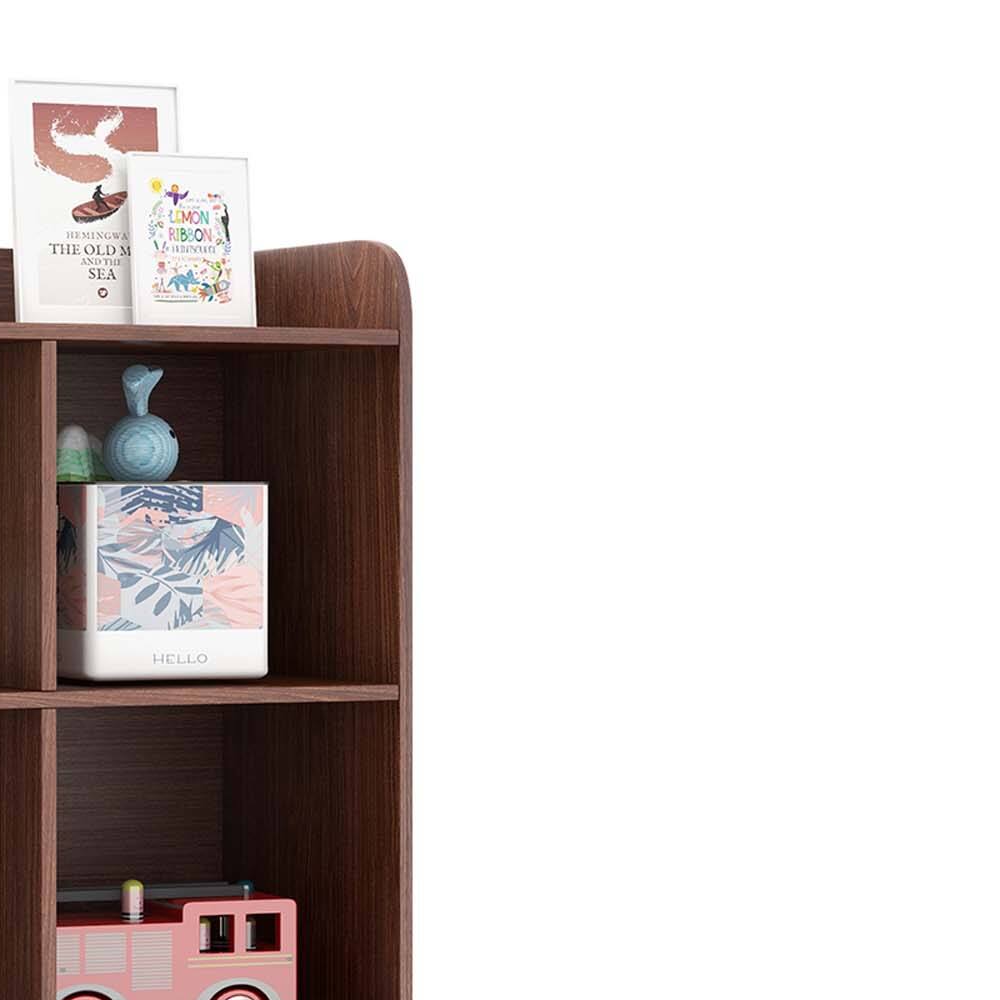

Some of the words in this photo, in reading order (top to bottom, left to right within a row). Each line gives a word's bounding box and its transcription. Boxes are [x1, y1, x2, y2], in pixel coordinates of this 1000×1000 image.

[168, 209, 209, 224] LEMON
[66, 231, 130, 240] HEMINGWA
[168, 227, 213, 242] RIBBON
[48, 242, 81, 255] THE
[83, 243, 117, 256] OLD
[119, 245, 131, 257] M
[80, 257, 102, 266] AND
[88, 267, 117, 280] SEA
[152, 653, 208, 664] HELLO
